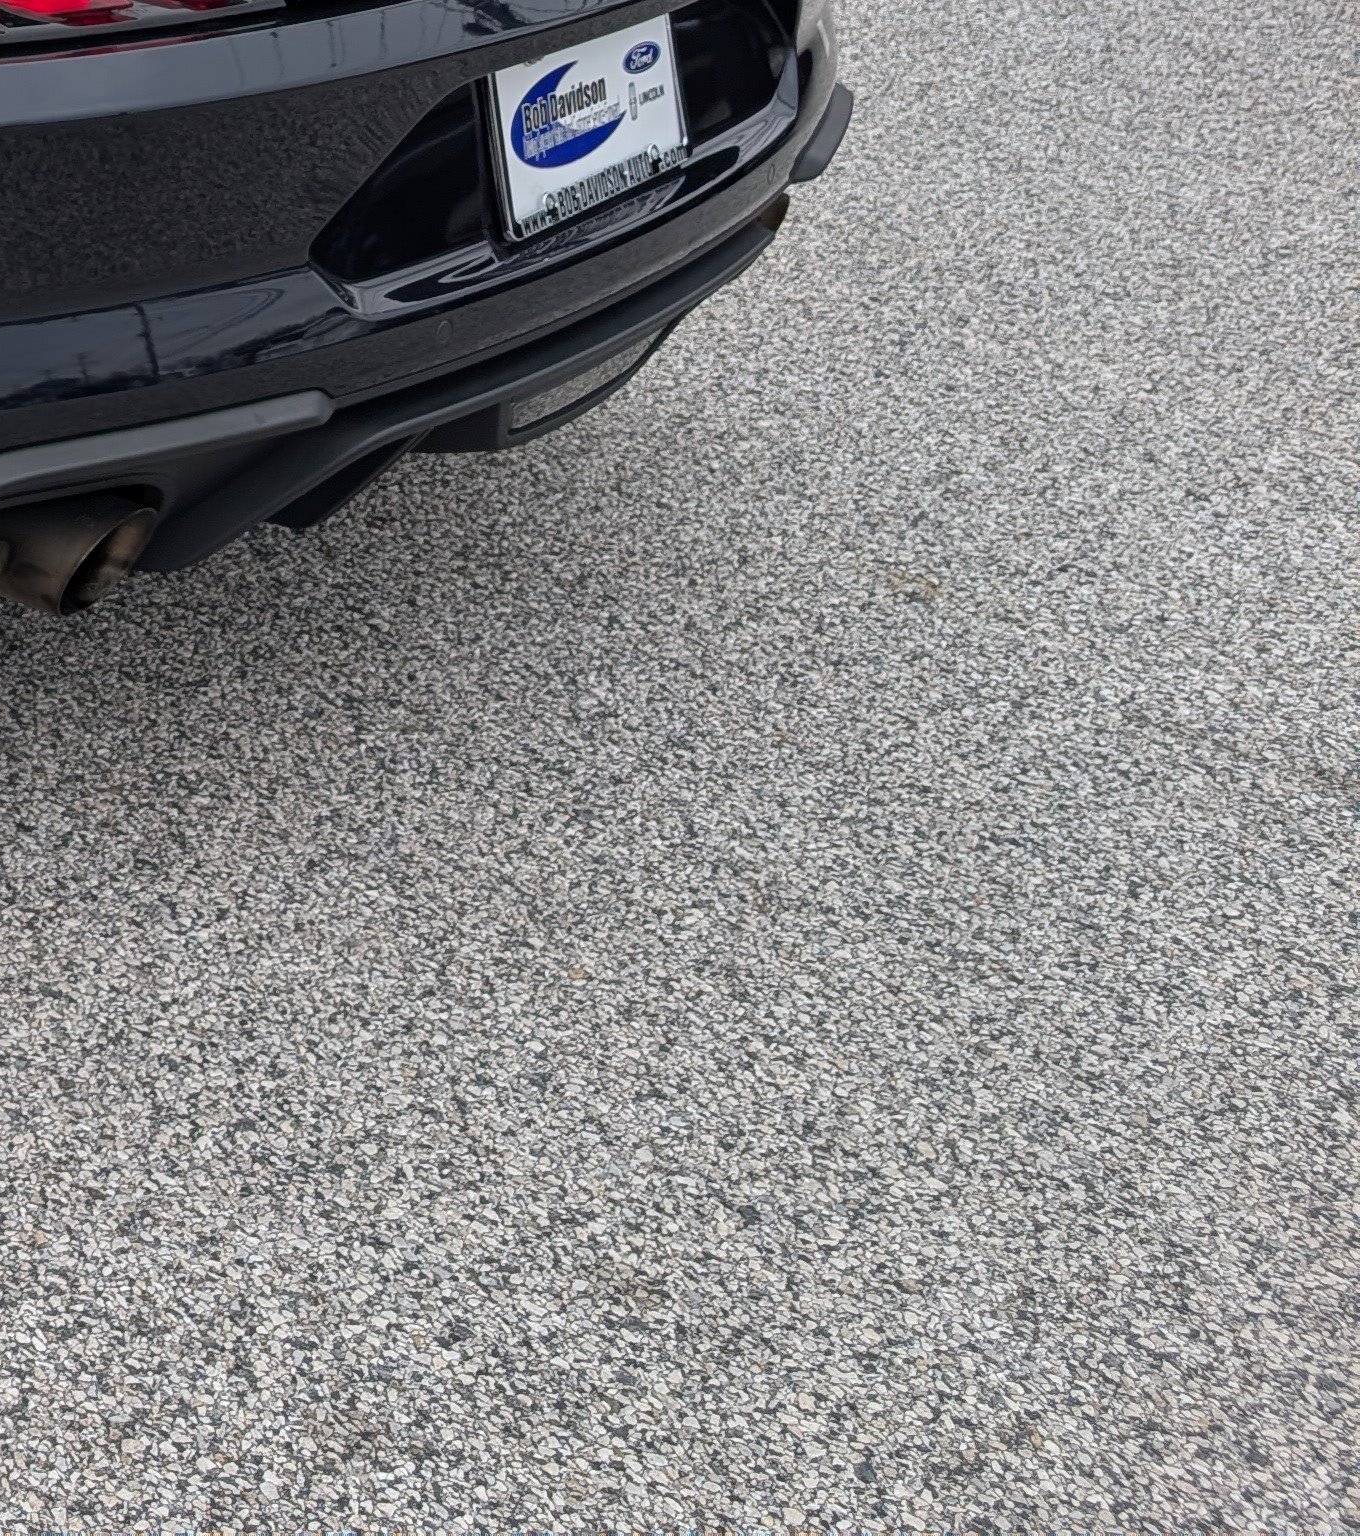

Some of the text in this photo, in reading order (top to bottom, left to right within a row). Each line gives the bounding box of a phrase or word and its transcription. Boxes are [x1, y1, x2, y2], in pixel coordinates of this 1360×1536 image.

[629, 46, 655, 70] Ford
[523, 77, 607, 134] Bob Davidson
[557, 185, 581, 218] BOB
[579, 163, 630, 208] DAVIDSON
[626, 152, 654, 184] AUTO
